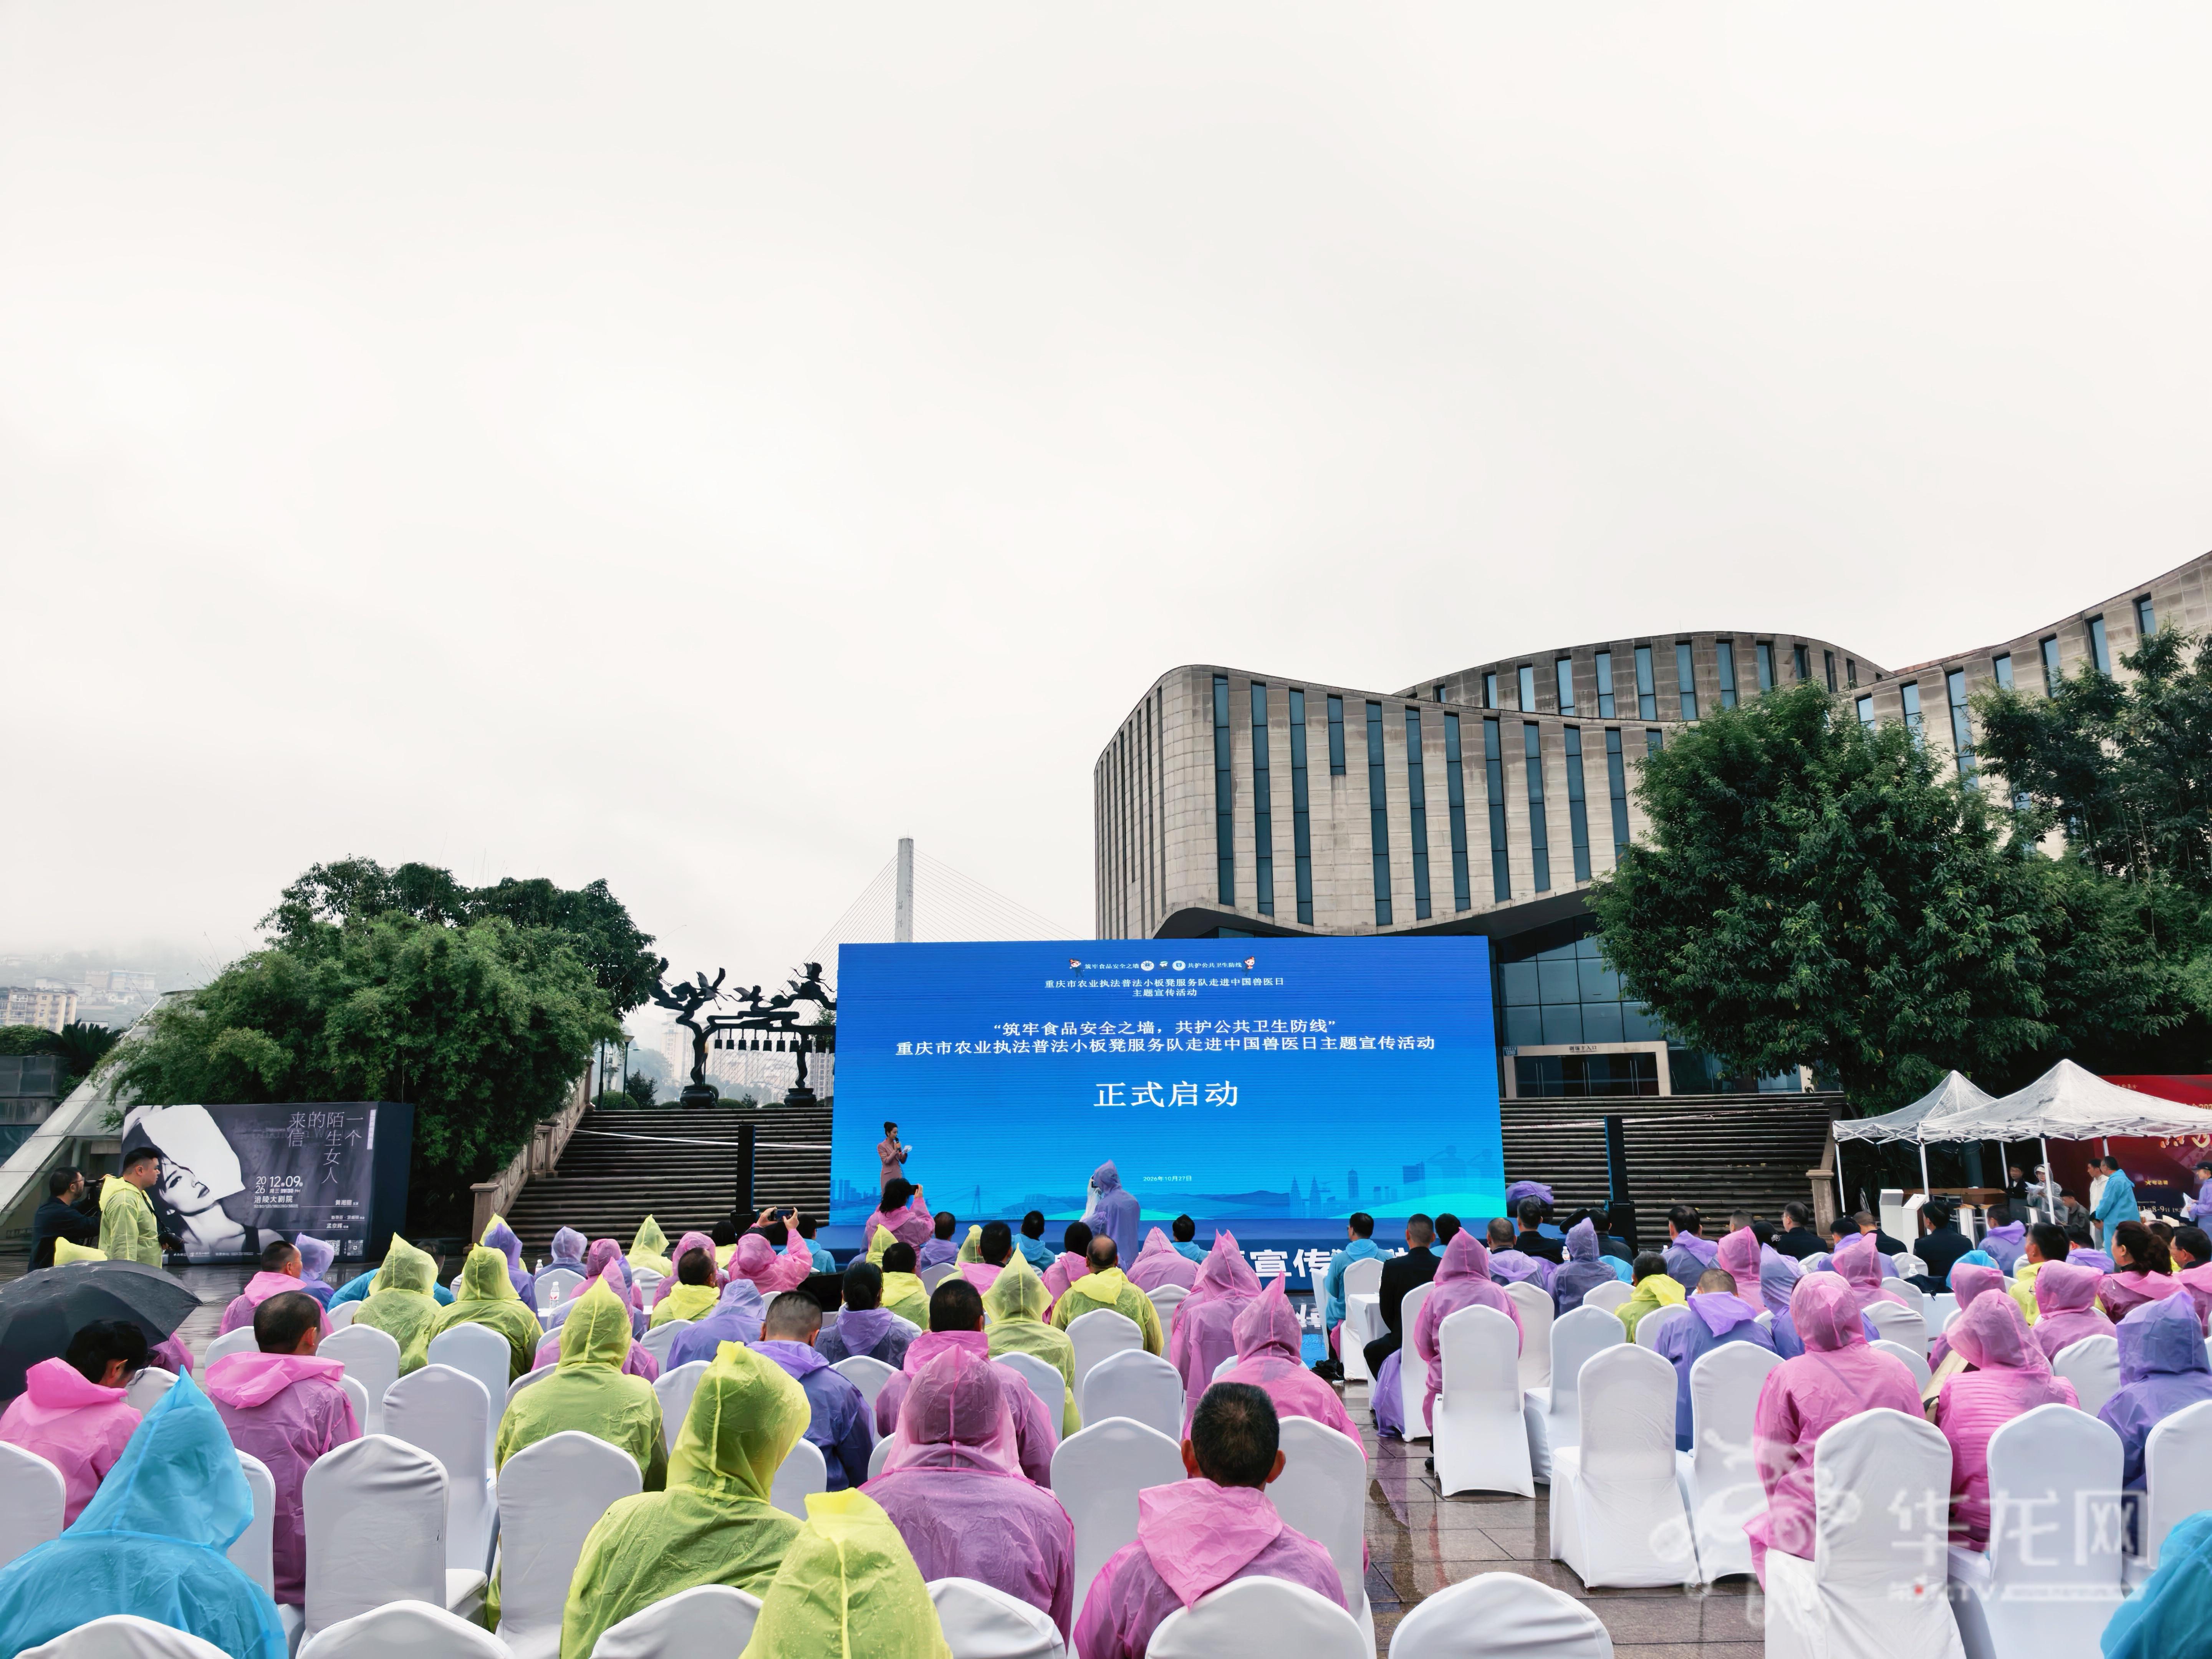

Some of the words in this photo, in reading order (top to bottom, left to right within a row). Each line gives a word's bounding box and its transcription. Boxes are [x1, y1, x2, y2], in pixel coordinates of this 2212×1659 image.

[1045, 977, 1284, 988] 重庆市农业执法普法小板凳服务队走进中国兽医日
[1132, 988, 1197, 997] 主题宣传活动
[994, 1019, 1335, 1036] “筑牢食品安全之墙，共护公共卫生防线”
[895, 1035, 1435, 1056] 重庆市农业执法普法小板凳服务队走进中国兽医日主题宣传活动
[1093, 1080, 1238, 1107] 正式启动
[287, 1111, 306, 1147] 来信
[345, 1117, 364, 1146] 一个
[321, 1111, 345, 1184] 陌生女人
[254, 1195, 293, 1203] 涪陵大剧院
